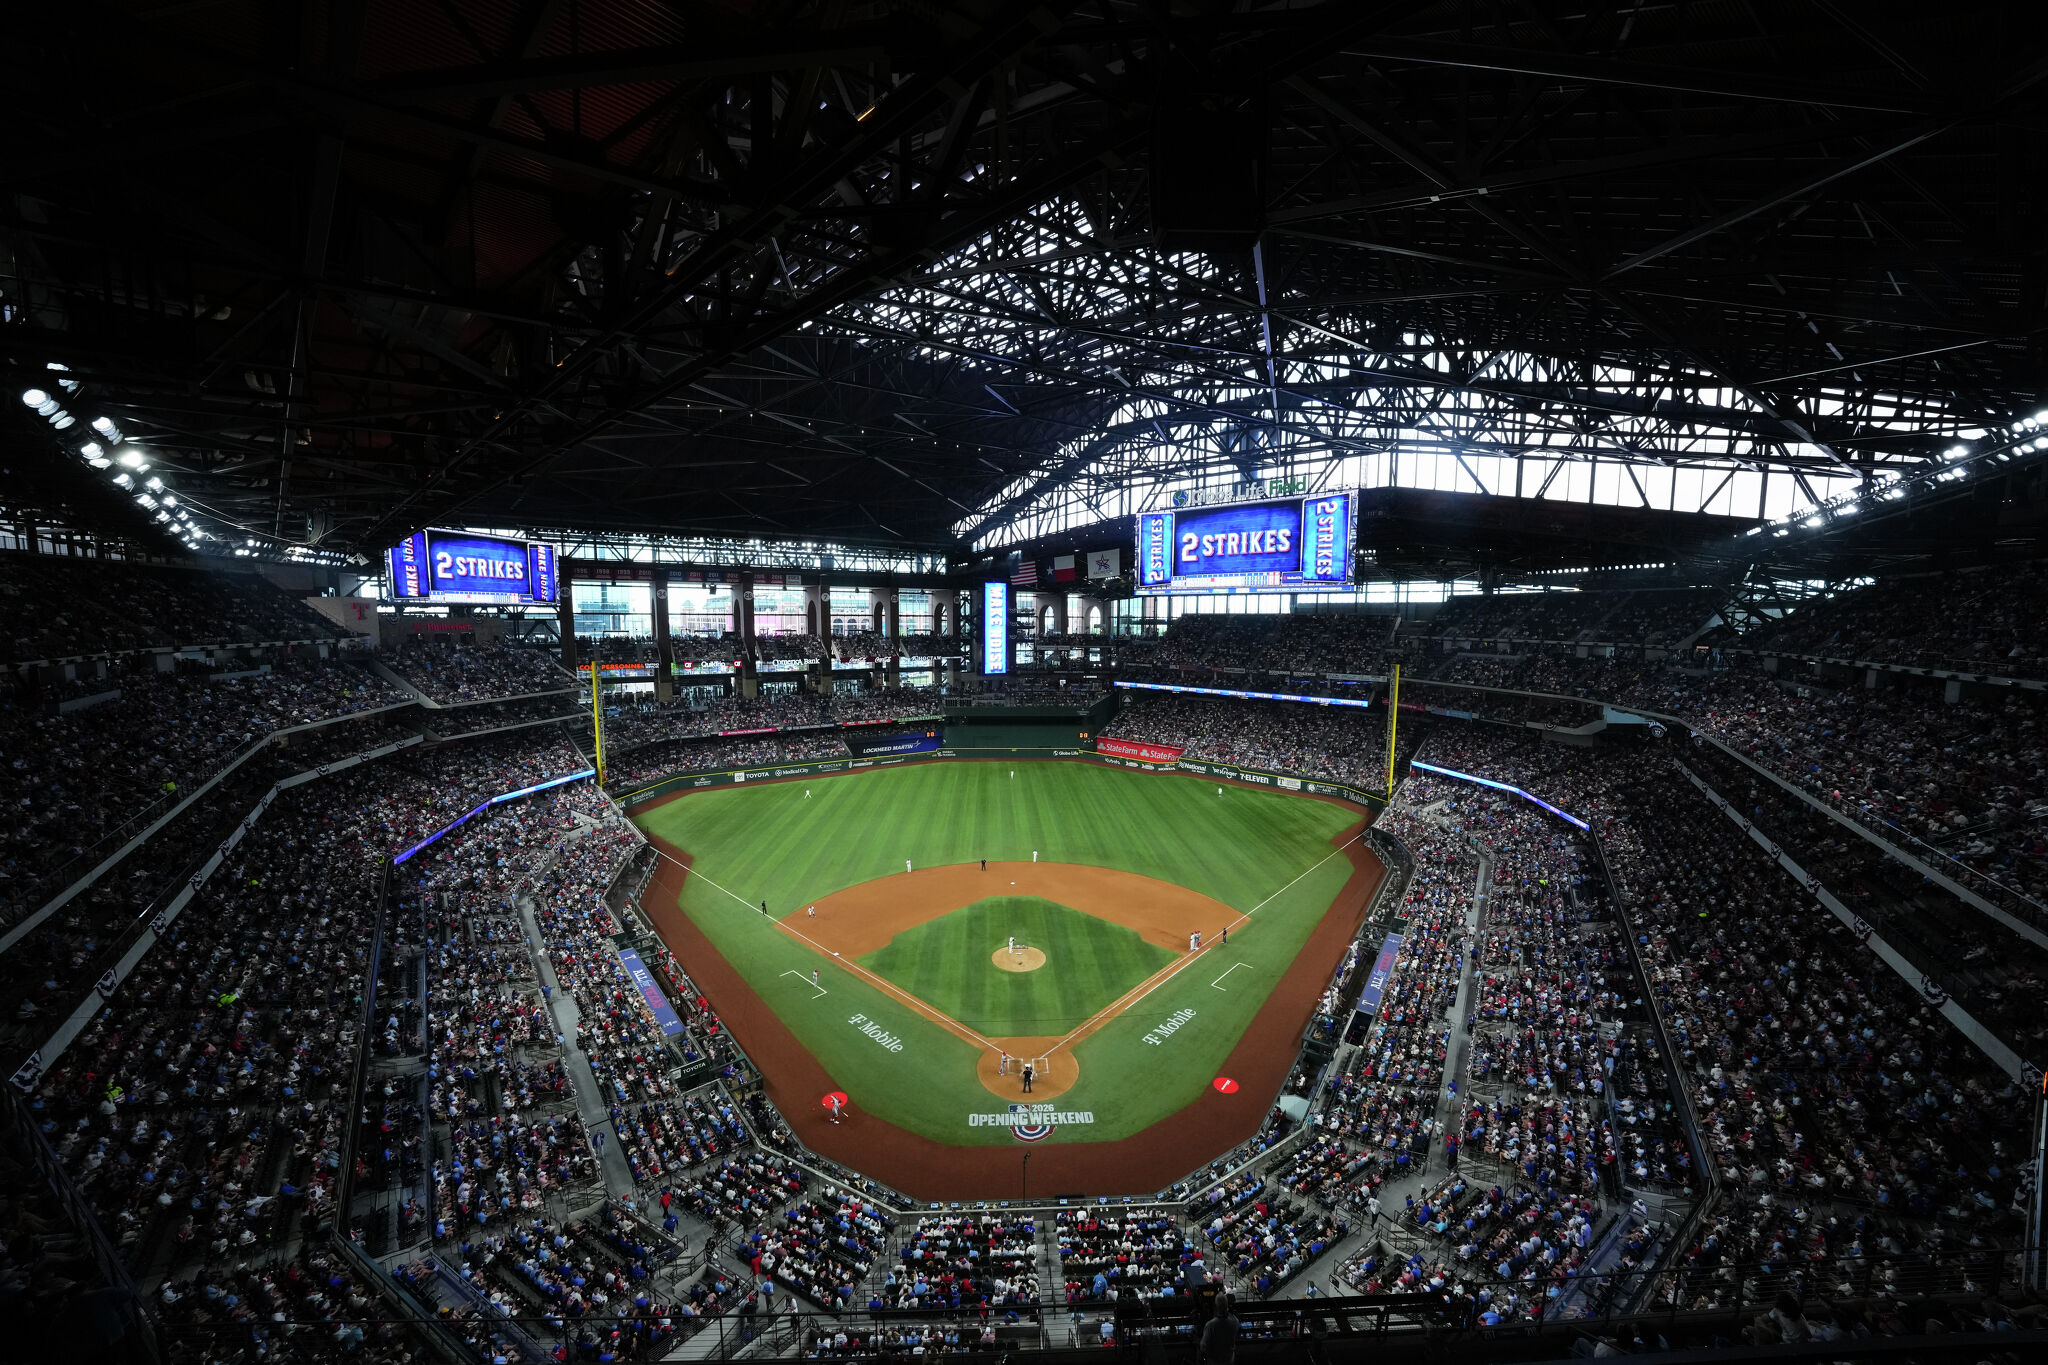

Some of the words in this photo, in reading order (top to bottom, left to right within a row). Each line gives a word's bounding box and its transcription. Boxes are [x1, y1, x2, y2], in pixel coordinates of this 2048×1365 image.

[1236, 483, 1266, 501] Life
[1269, 476, 1306, 495] Field
[1316, 500, 1338, 515] 2
[403, 536, 414, 562] NOIS
[1152, 518, 1164, 569] STRIKES
[1182, 532, 1200, 562] 2
[1202, 528, 1292, 557] STRIKES
[1317, 516, 1334, 576] STRIKES
[436, 552, 454, 580] 2
[456, 556, 524, 580] STRIKES
[537, 545, 548, 572] MAKE
[406, 565, 420, 597] MAKE
[540, 574, 548, 601] NOISE
[1150, 570, 1164, 582] 2
[990, 586, 1003, 626] MAKE
[990, 628, 1003, 672] NOISE
[863, 744, 892, 754] LOCKHEED
[1168, 754, 1180, 762] Far
[1184, 762, 1206, 771] National
[1219, 768, 1237, 779] Kroger
[1349, 792, 1368, 806] Mobile
[633, 968, 648, 982] ALL
[644, 986, 664, 1008] TEXAS
[1370, 977, 1384, 990] ALL
[1154, 1007, 1196, 1038] Mobile
[860, 1020, 904, 1054] Mobile
[968, 1114, 1028, 1126] OPENING
[1028, 1112, 1094, 1125] WEEKEND
[1032, 1104, 1054, 1112] 2026
